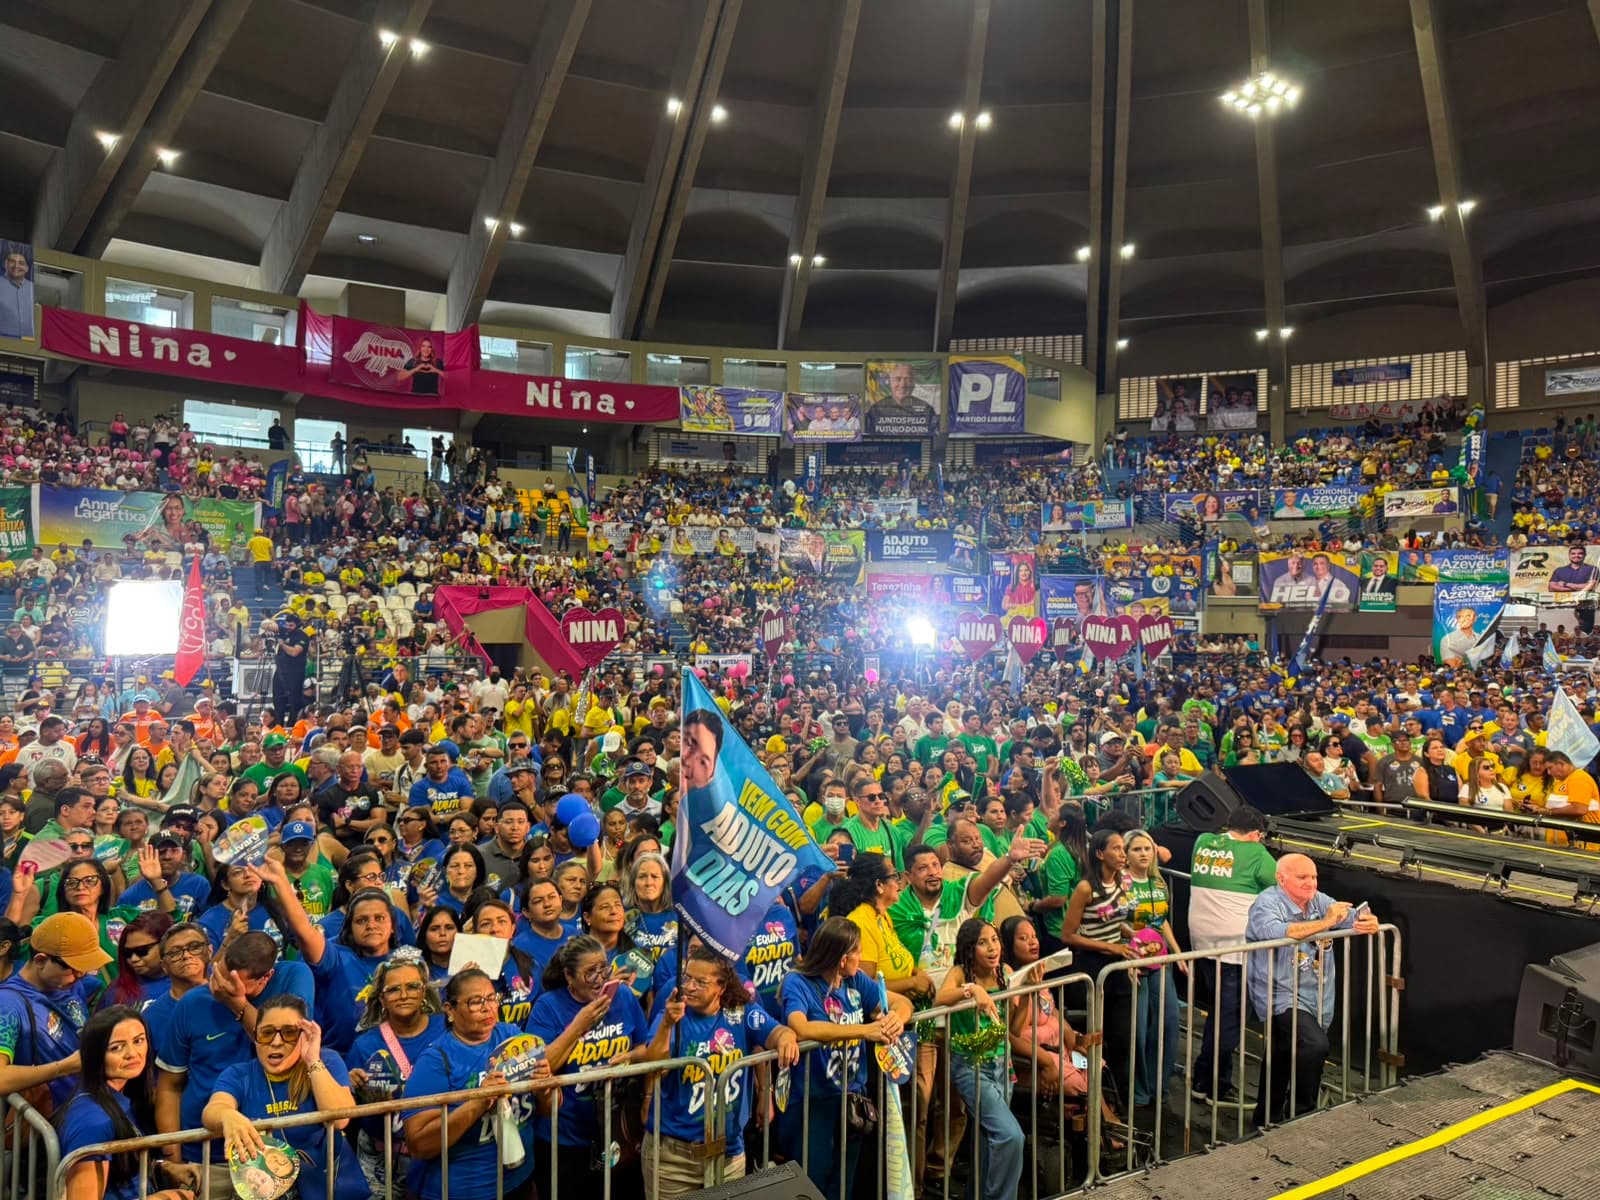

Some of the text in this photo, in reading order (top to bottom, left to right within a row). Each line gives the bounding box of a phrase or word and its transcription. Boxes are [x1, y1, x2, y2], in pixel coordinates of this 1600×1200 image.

[88, 324, 212, 368] Nina
[367, 343, 404, 360] NINA
[525, 381, 616, 415] Nina
[957, 373, 1016, 413] PL
[878, 416, 926, 424] JUNTOS PELO
[956, 415, 1016, 423] PARTIDO LIBERAL
[79, 497, 118, 511] Anne
[1300, 491, 1358, 505] Azeved
[74, 505, 146, 523] Lagartixa
[883, 535, 928, 545] ADJUTO
[883, 545, 910, 555] DIAS
[1441, 558, 1507, 569] Azevedo
[569, 619, 619, 644] NINA
[764, 617, 784, 642] NINA
[959, 622, 996, 642] NINA
[1012, 624, 1042, 644] NINA
[1054, 627, 1070, 643] NINA
[1086, 623, 1117, 645] NINA
[1141, 622, 1172, 645] NINA
[738, 779, 809, 850] VEM COM
[700, 801, 799, 888] ADJUTO
[1210, 865, 1233, 878] RN
[686, 849, 759, 917] DIAS
[756, 933, 787, 945] EQUIPE
[745, 941, 794, 965] ADJUTO
[753, 957, 792, 987] DIAS
[567, 1036, 631, 1066] ADJUTO
[266, 1100, 298, 1114] BRASIL
